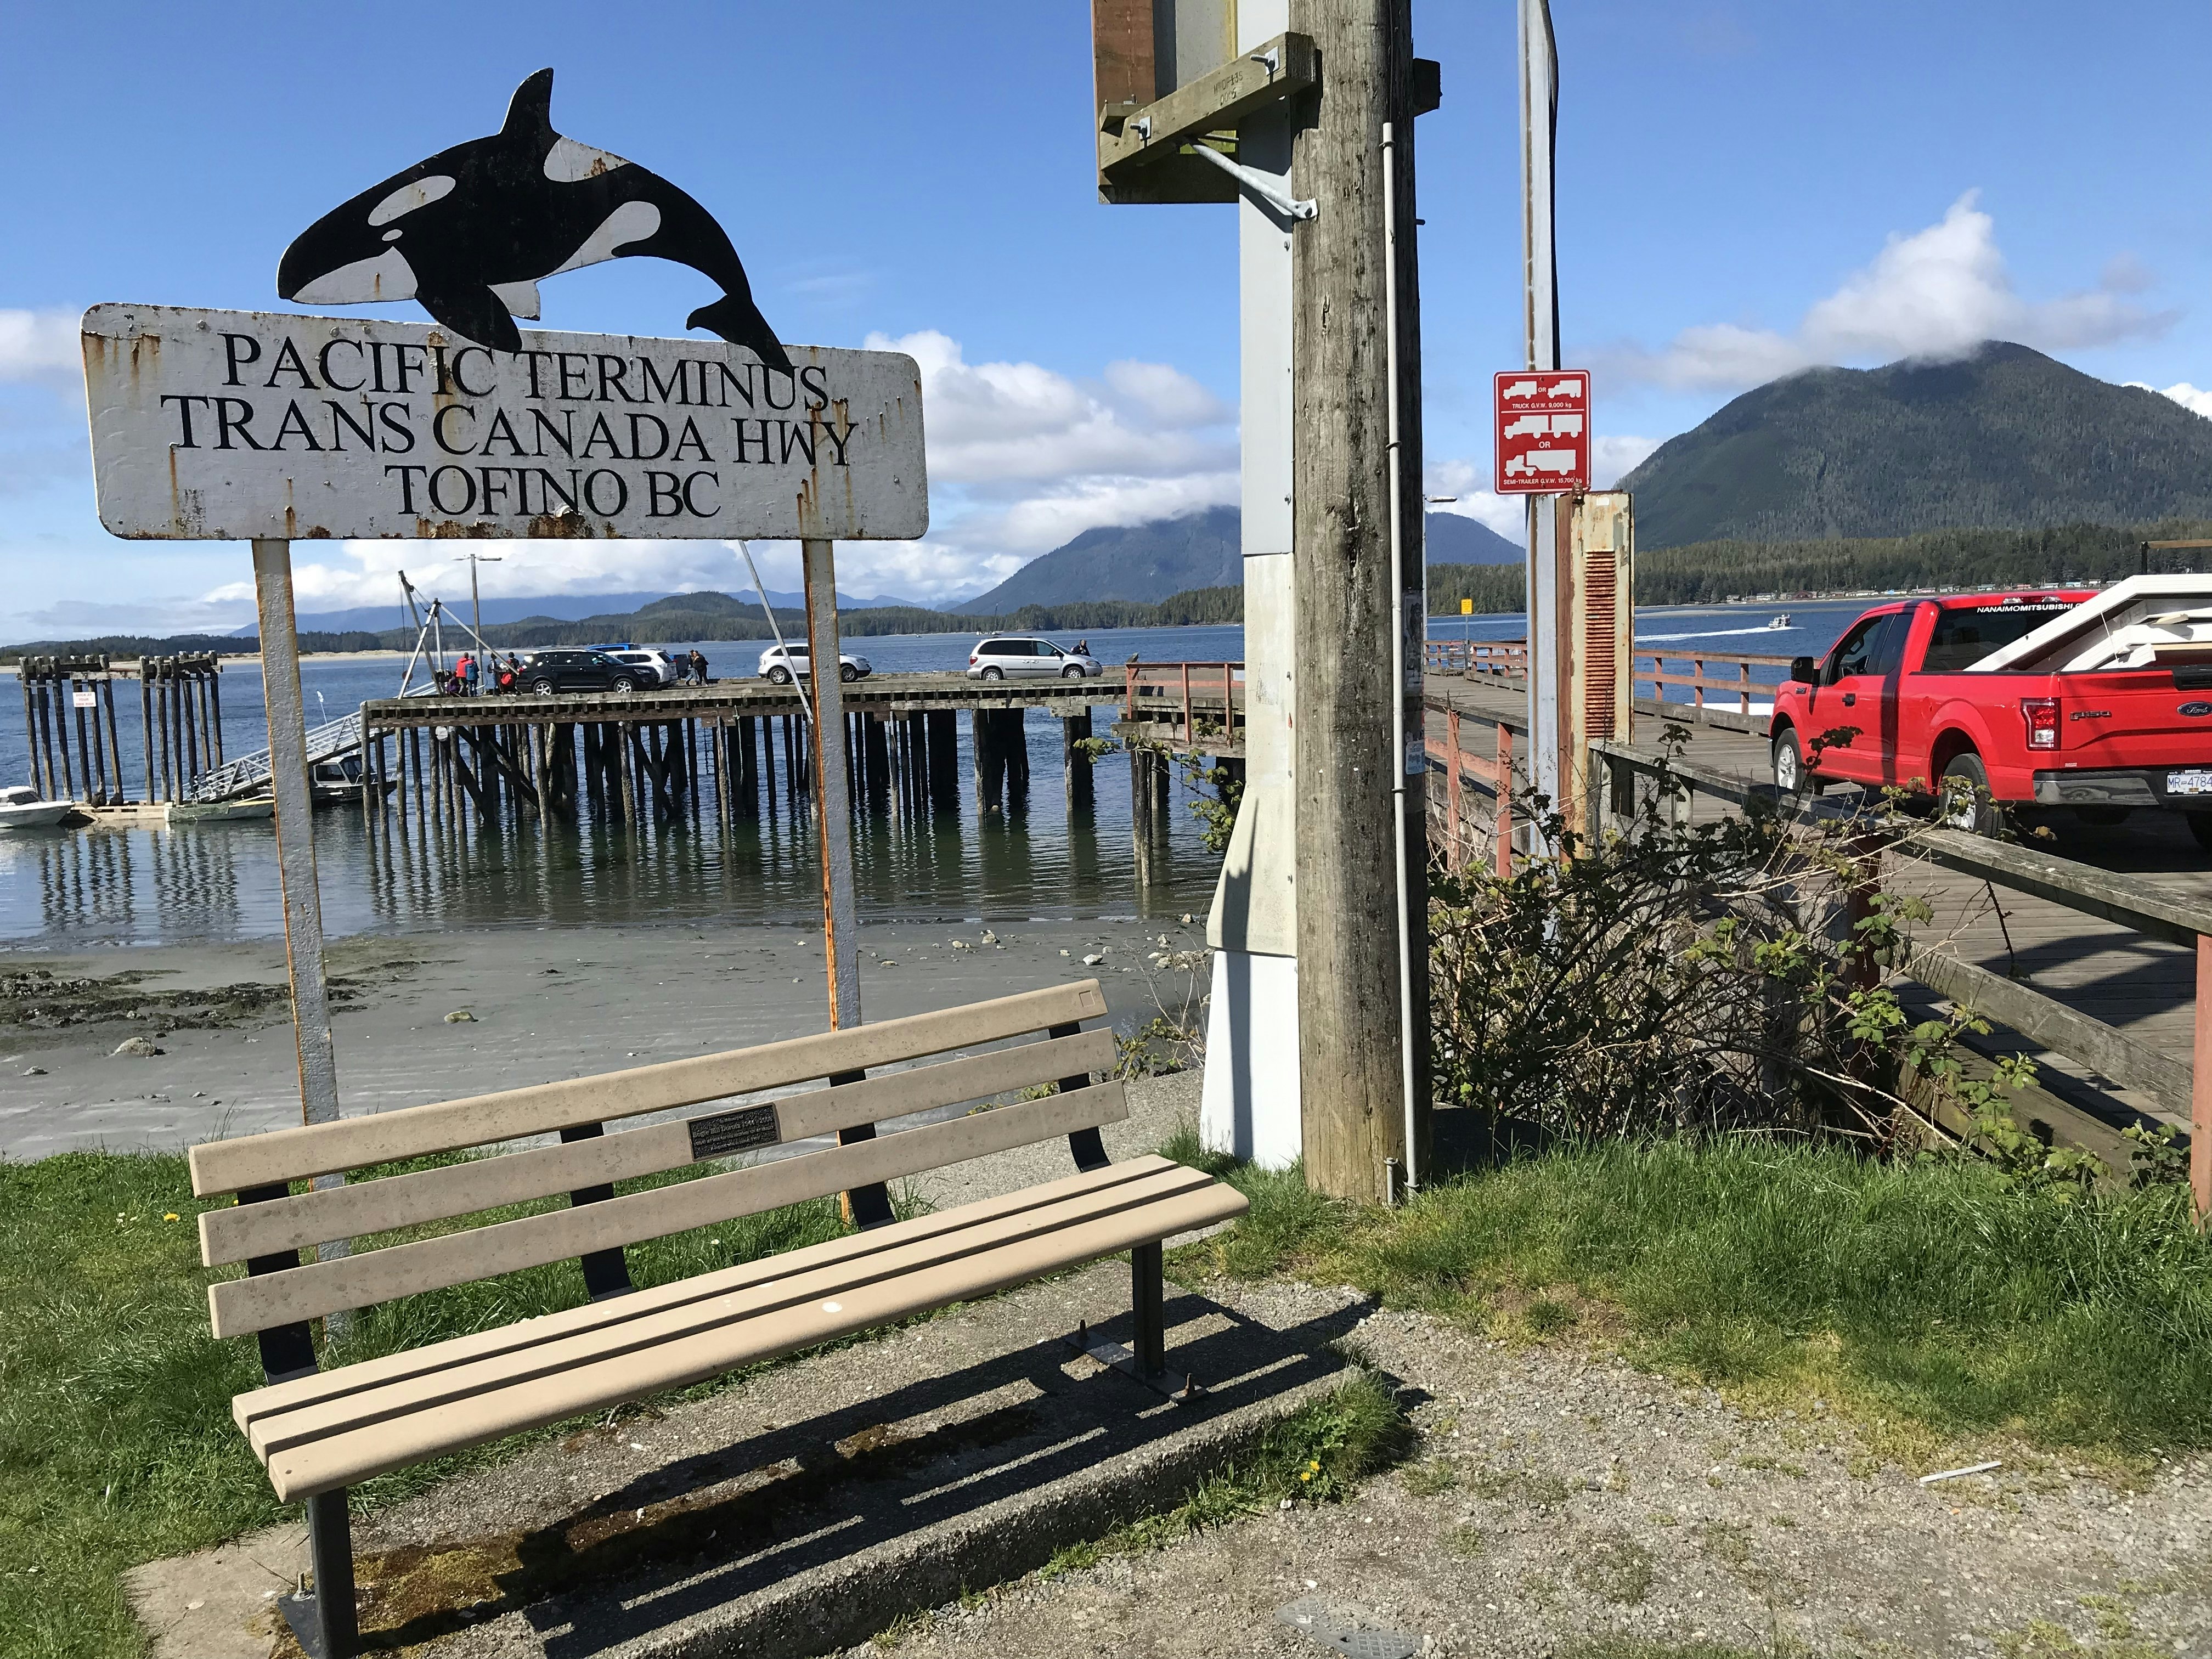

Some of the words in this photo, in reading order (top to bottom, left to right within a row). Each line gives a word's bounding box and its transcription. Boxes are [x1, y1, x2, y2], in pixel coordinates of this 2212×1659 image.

[217, 333, 496, 397] PACIFIC
[514, 351, 828, 411] TERMINUS
[161, 395, 415, 453] TRANS
[433, 405, 715, 461] CANADA
[731, 417, 859, 466] HWY
[385, 465, 628, 517] TOFINO
[644, 471, 721, 517] BC
[2187, 706, 2208, 714] Ford
[2168, 777, 2181, 788] MR
